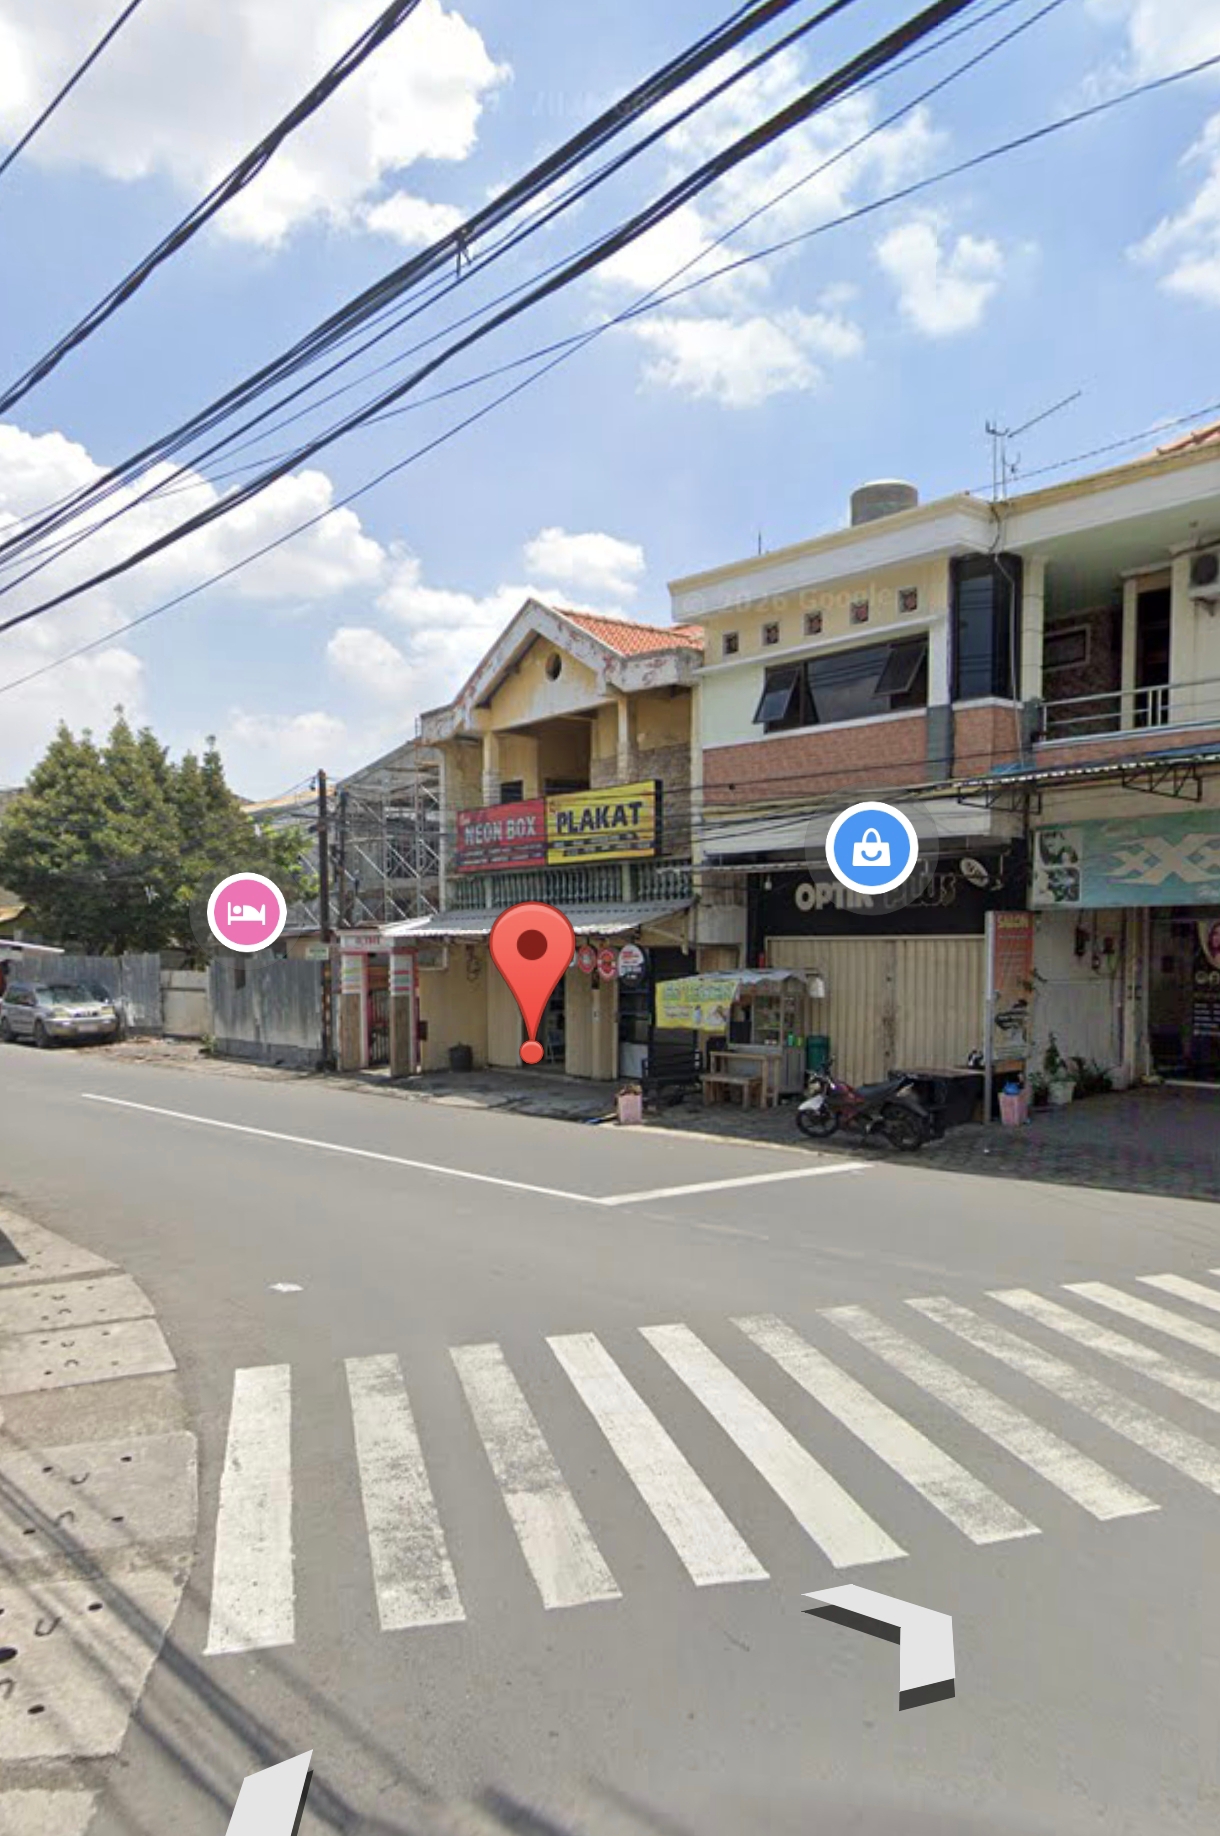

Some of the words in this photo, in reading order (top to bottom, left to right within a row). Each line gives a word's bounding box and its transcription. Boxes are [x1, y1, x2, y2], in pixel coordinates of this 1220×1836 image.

[464, 820, 502, 846] NEON
[506, 815, 537, 841] BOX
[556, 801, 644, 834] PLAKAT
